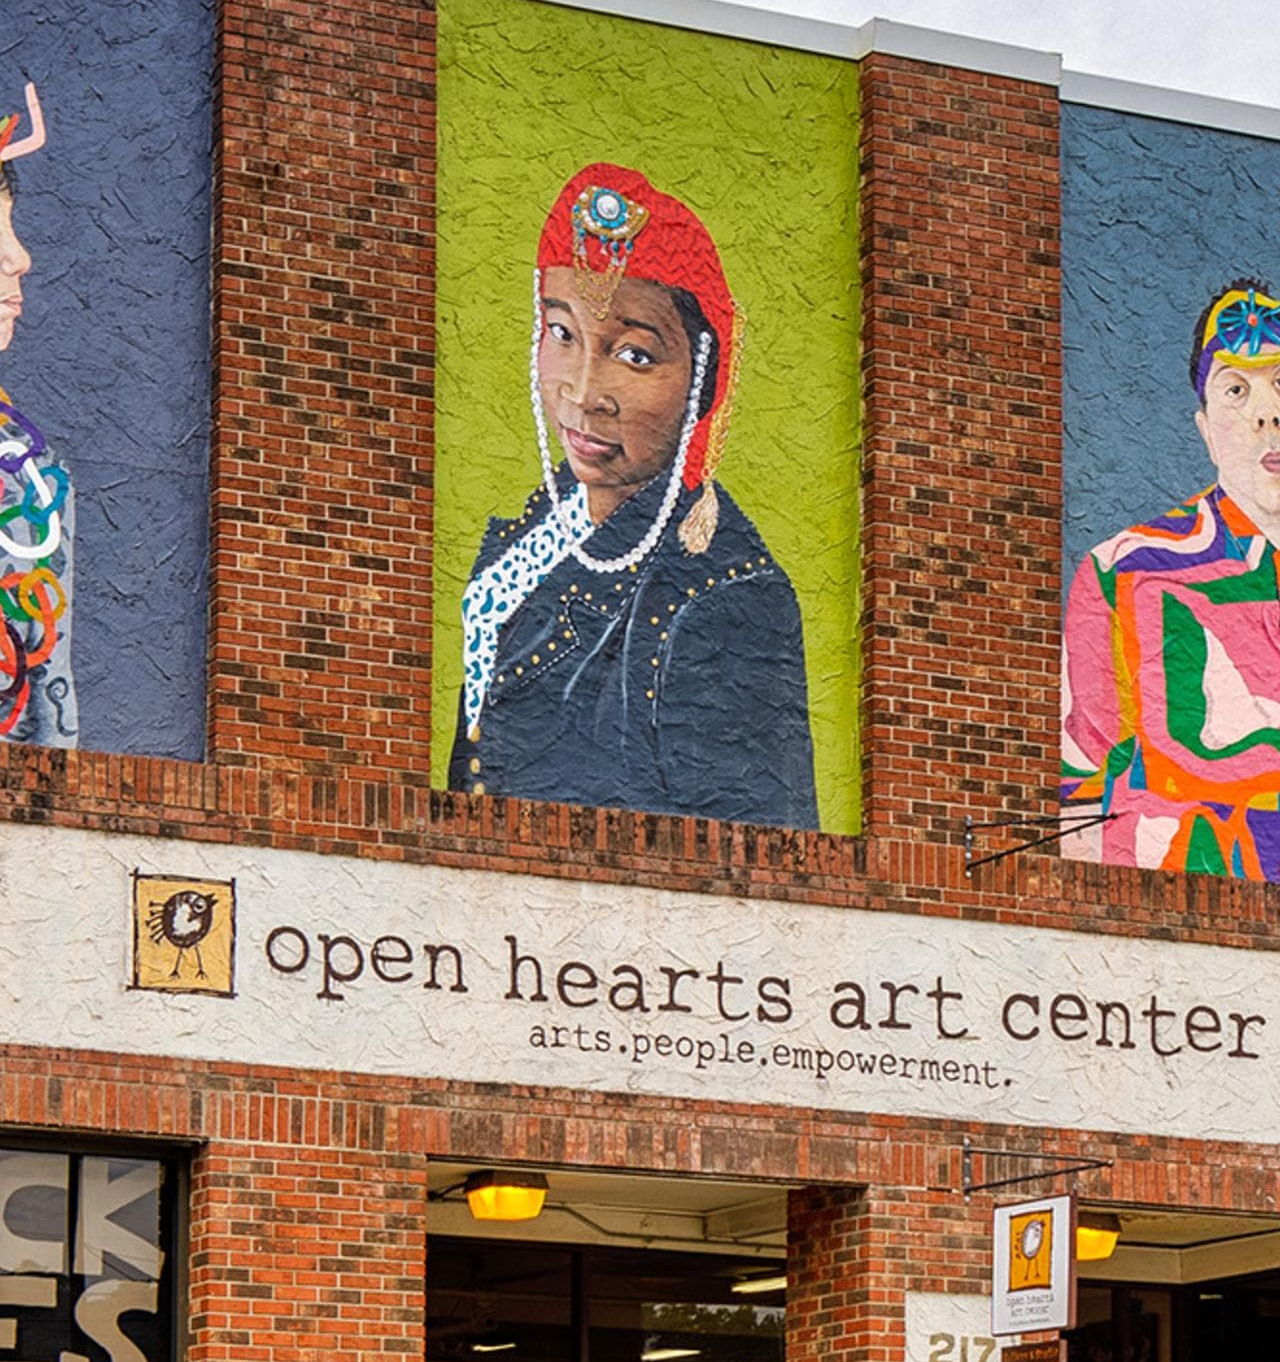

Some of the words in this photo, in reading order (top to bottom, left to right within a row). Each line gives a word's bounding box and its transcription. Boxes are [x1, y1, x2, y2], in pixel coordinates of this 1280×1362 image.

[265, 925, 468, 1002] open
[503, 935, 793, 1023] hearts
[830, 974, 980, 1040] art
[1001, 992, 1267, 1059] center
